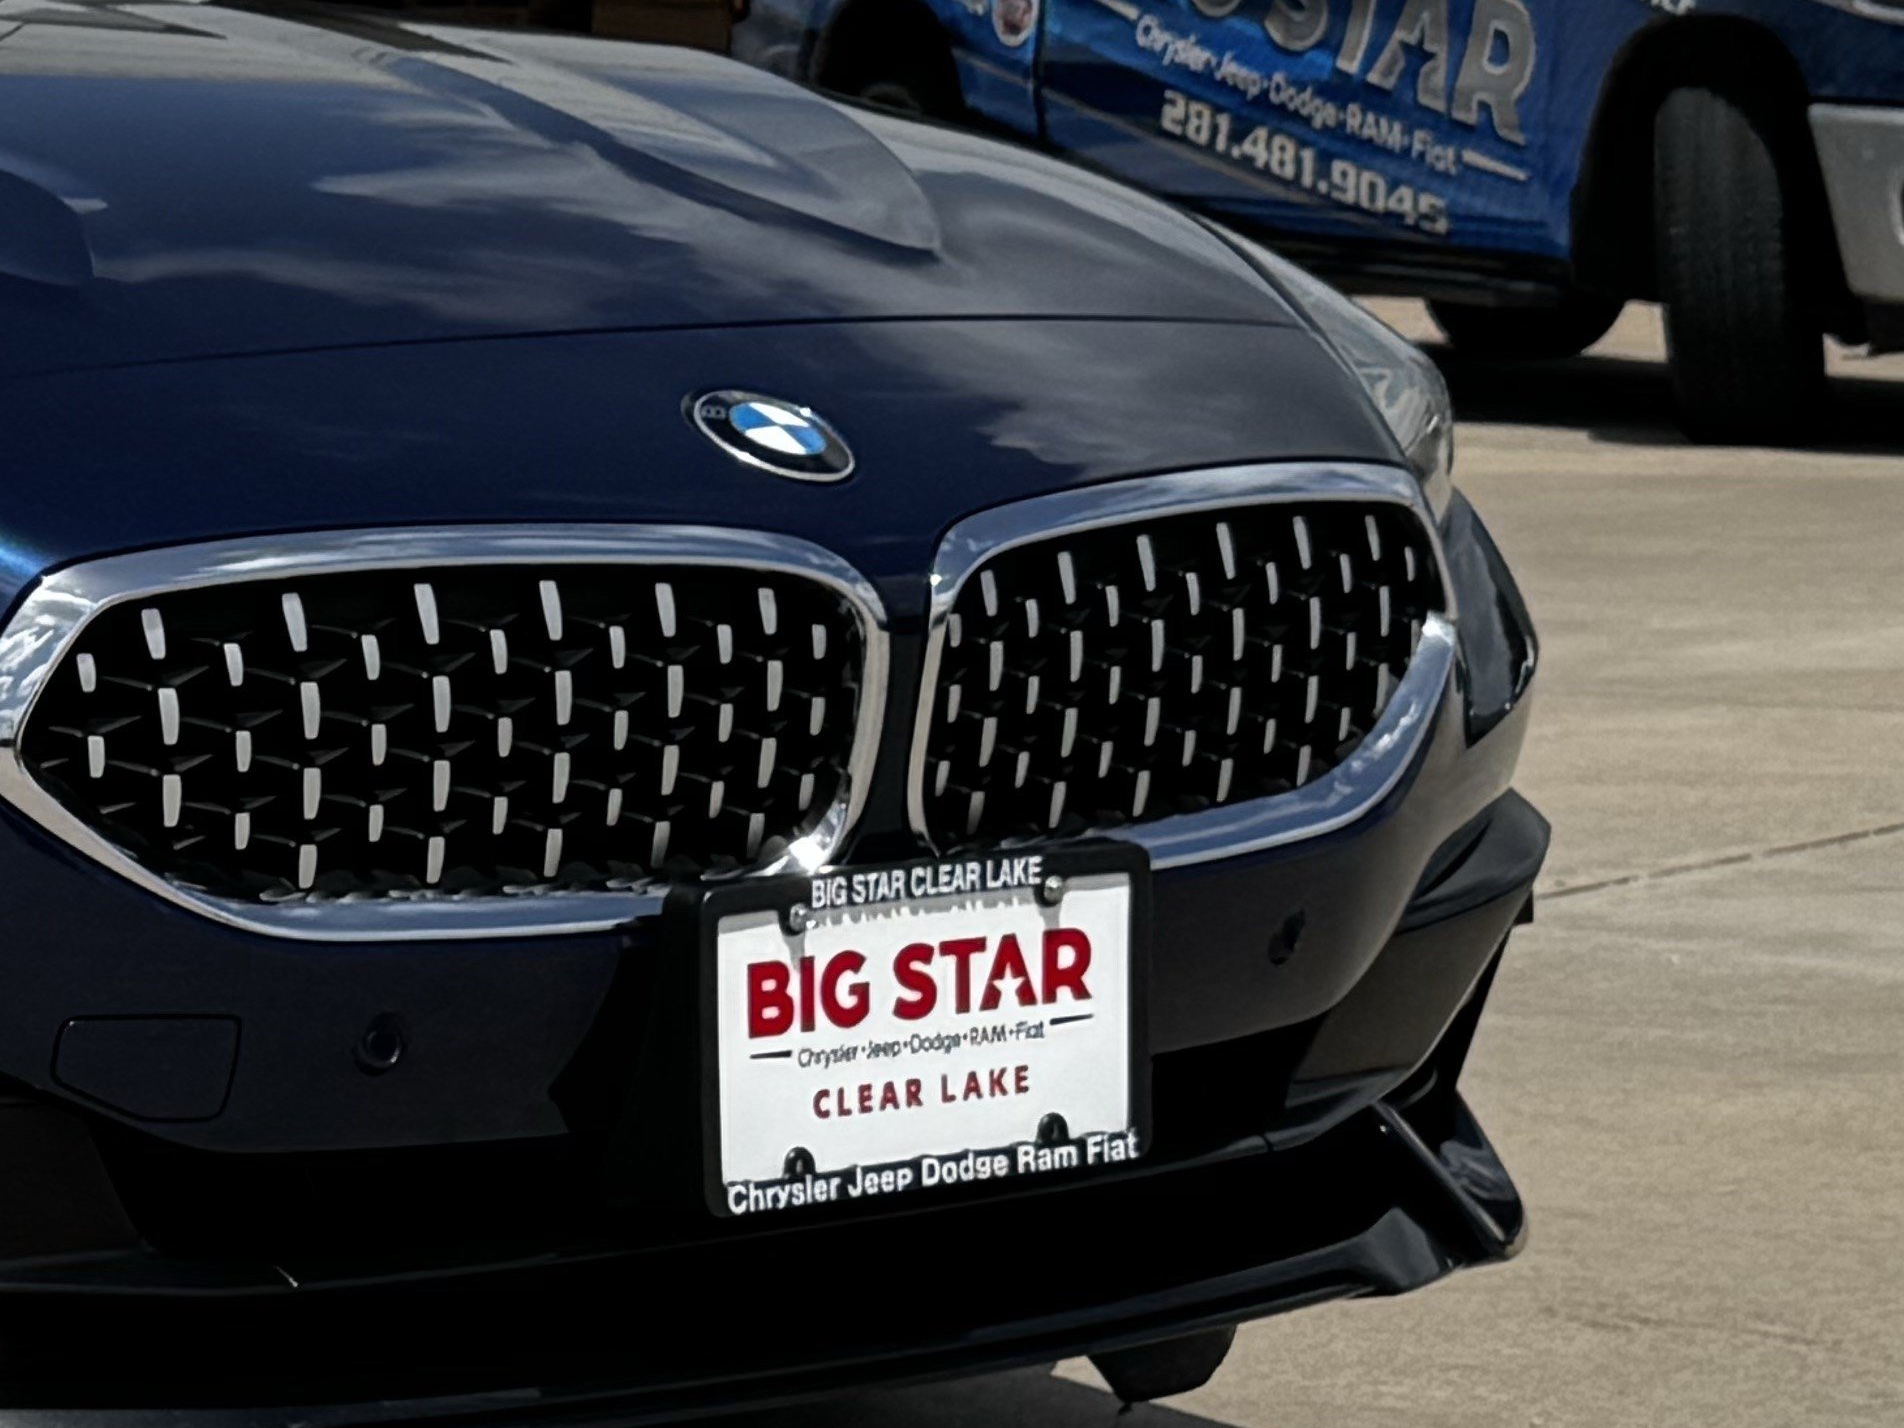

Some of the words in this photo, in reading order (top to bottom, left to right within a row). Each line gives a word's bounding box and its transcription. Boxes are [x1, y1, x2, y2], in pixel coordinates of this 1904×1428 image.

[1160, 88, 1451, 236] 281.481.9045
[812, 878, 848, 909] BIG
[850, 869, 905, 905] STAR
[910, 862, 982, 897] CLEAR
[986, 855, 1043, 889] LAKE
[747, 949, 871, 1039] BIG
[892, 927, 1092, 1022] STAR
[797, 1041, 857, 1070] Chrysler
[866, 1037, 902, 1062] Jeep
[910, 1028, 962, 1057] Dodge
[969, 1023, 1008, 1048] RAM
[1014, 1019, 1046, 1042] Fiat
[812, 1078, 923, 1119] CLEAR
[940, 1064, 1031, 1105] LAKE
[727, 1172, 841, 1216] Chrysler
[847, 1166, 912, 1199] Jeep
[920, 1150, 1009, 1186] Dodge
[1017, 1143, 1079, 1175] Ram
[1086, 1128, 1140, 1164] Fiat
